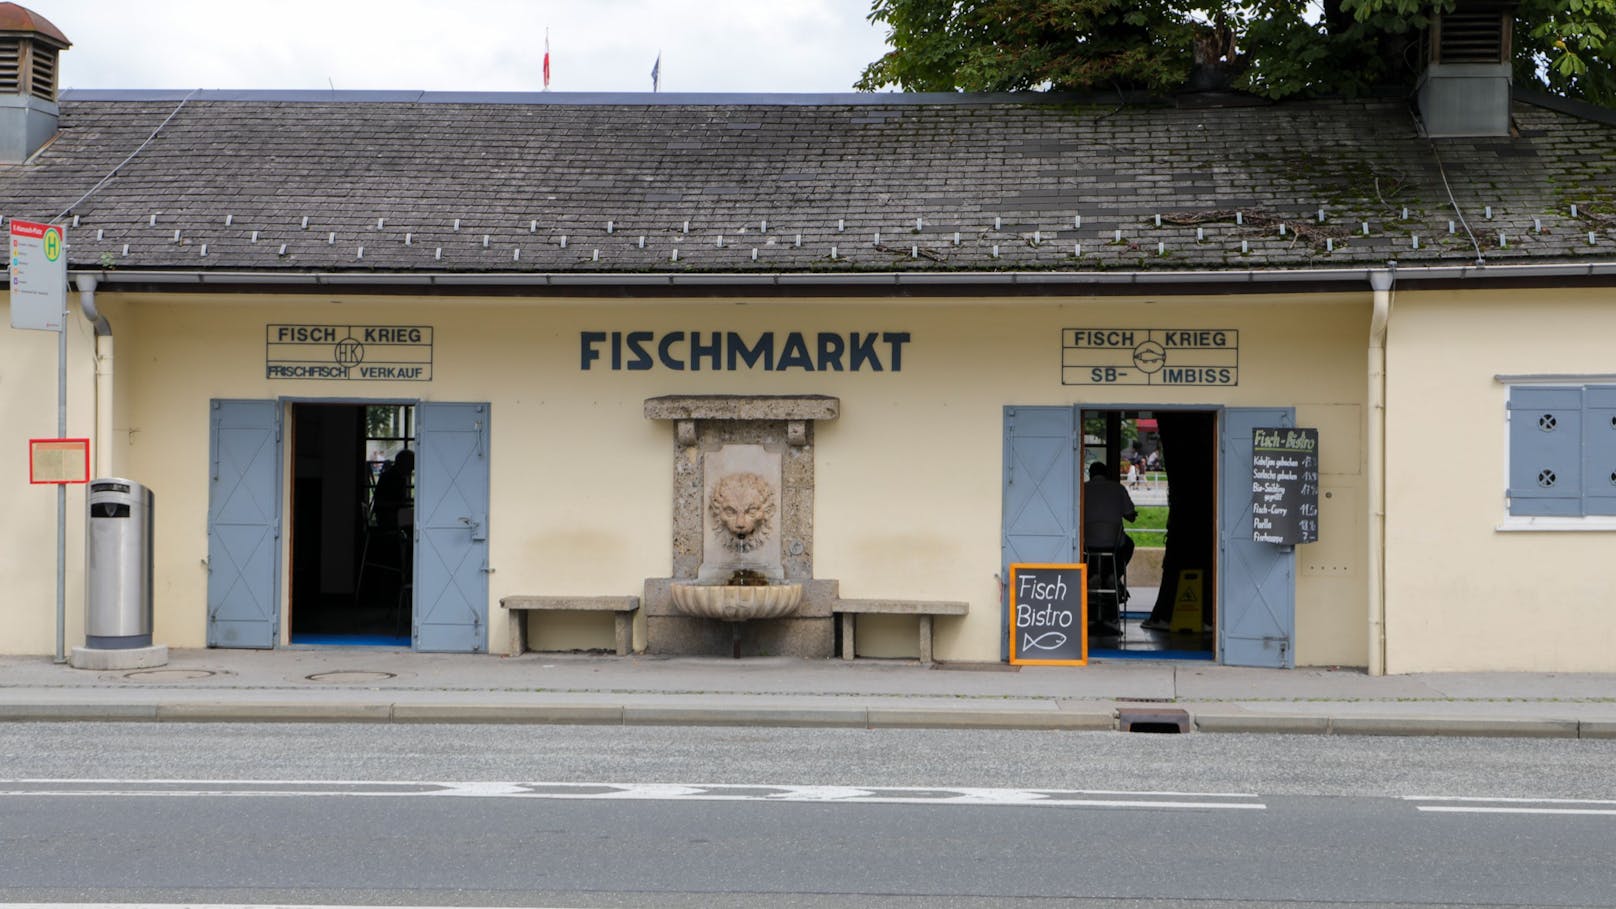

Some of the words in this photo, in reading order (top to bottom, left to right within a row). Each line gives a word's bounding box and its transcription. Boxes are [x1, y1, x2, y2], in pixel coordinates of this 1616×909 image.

[47, 235, 57, 257] H
[278, 327, 336, 342] FISCH
[364, 328, 421, 343] KRIEG
[1074, 331, 1134, 346] FISCH
[1165, 332, 1227, 346] KRIEG
[580, 331, 911, 372] FISCHMARKT
[267, 365, 347, 378] FRISCHFISCH
[360, 367, 424, 379] VERKAUF
[1091, 368, 1128, 383] SB-
[1162, 368, 1232, 384] IMBISS
[1018, 574, 1067, 601] Fisch
[1016, 603, 1073, 628] Bistro
